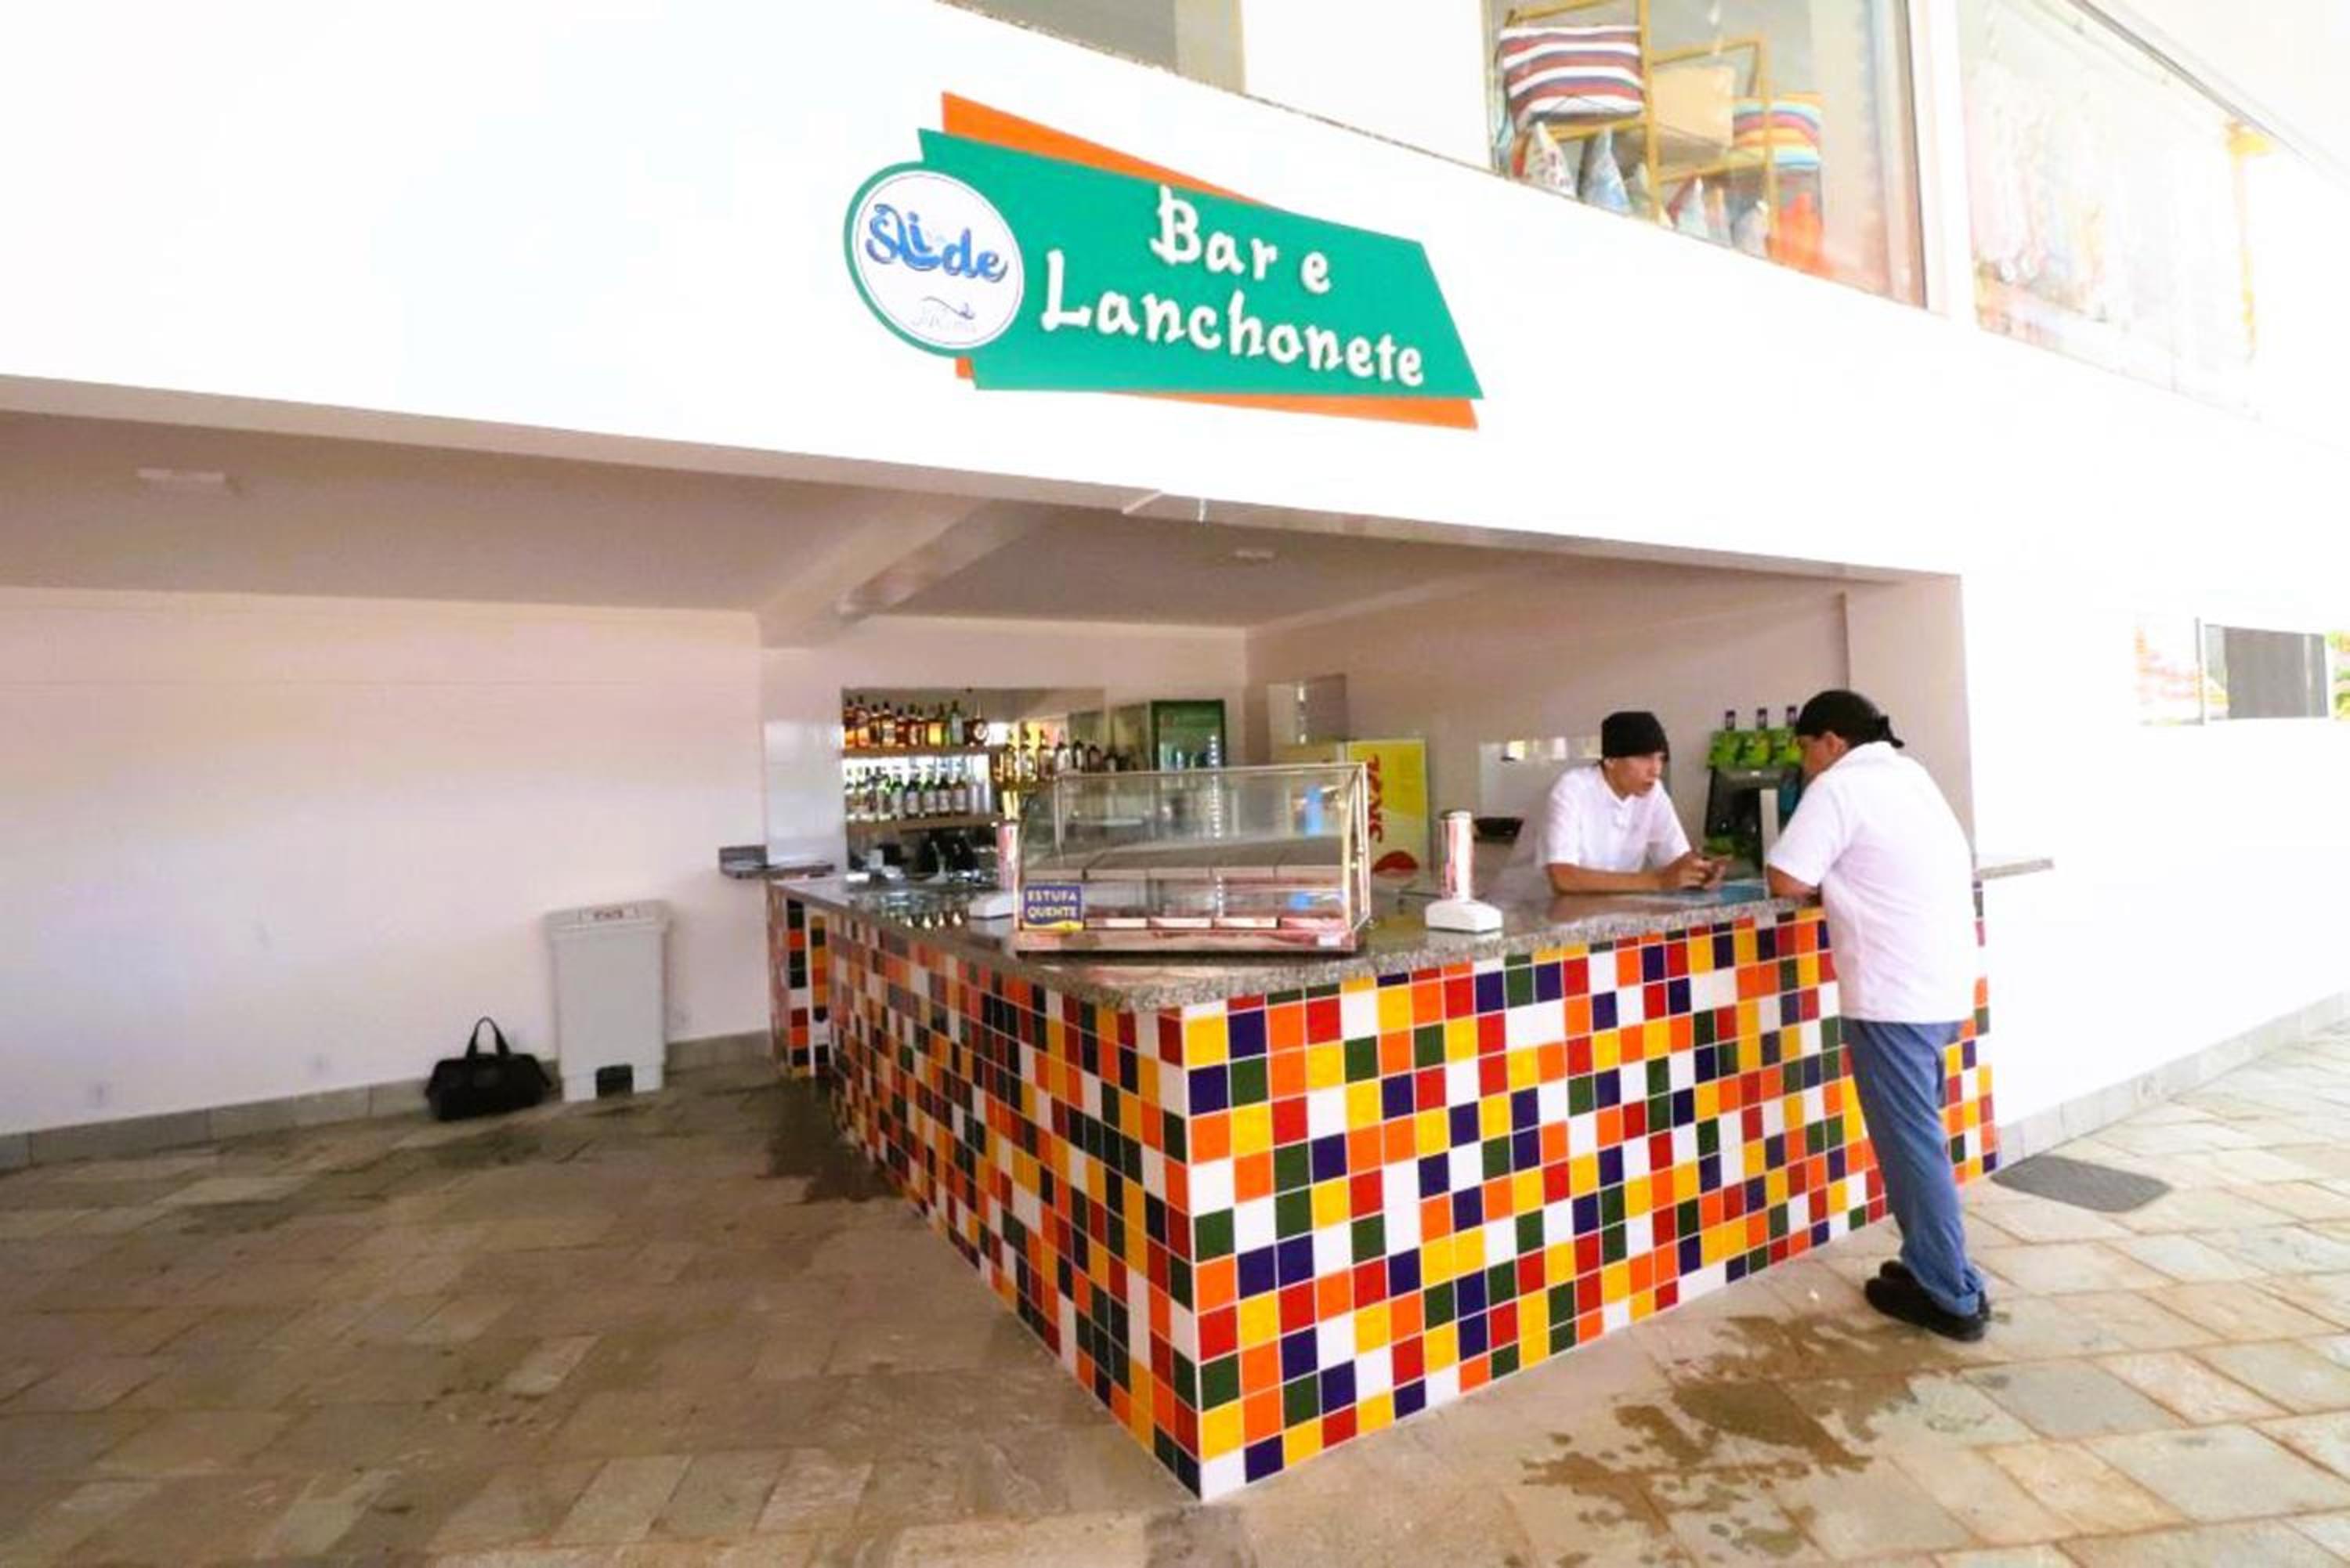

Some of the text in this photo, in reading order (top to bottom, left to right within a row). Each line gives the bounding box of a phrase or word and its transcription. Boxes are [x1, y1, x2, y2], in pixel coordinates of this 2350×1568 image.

[866, 203, 1008, 283] Slide
[1150, 185, 1330, 294] Bar e
[1041, 250, 1424, 387] Lanchonete
[1027, 889, 1077, 902] ESTUFA
[1027, 905, 1077, 918] QUENTE
